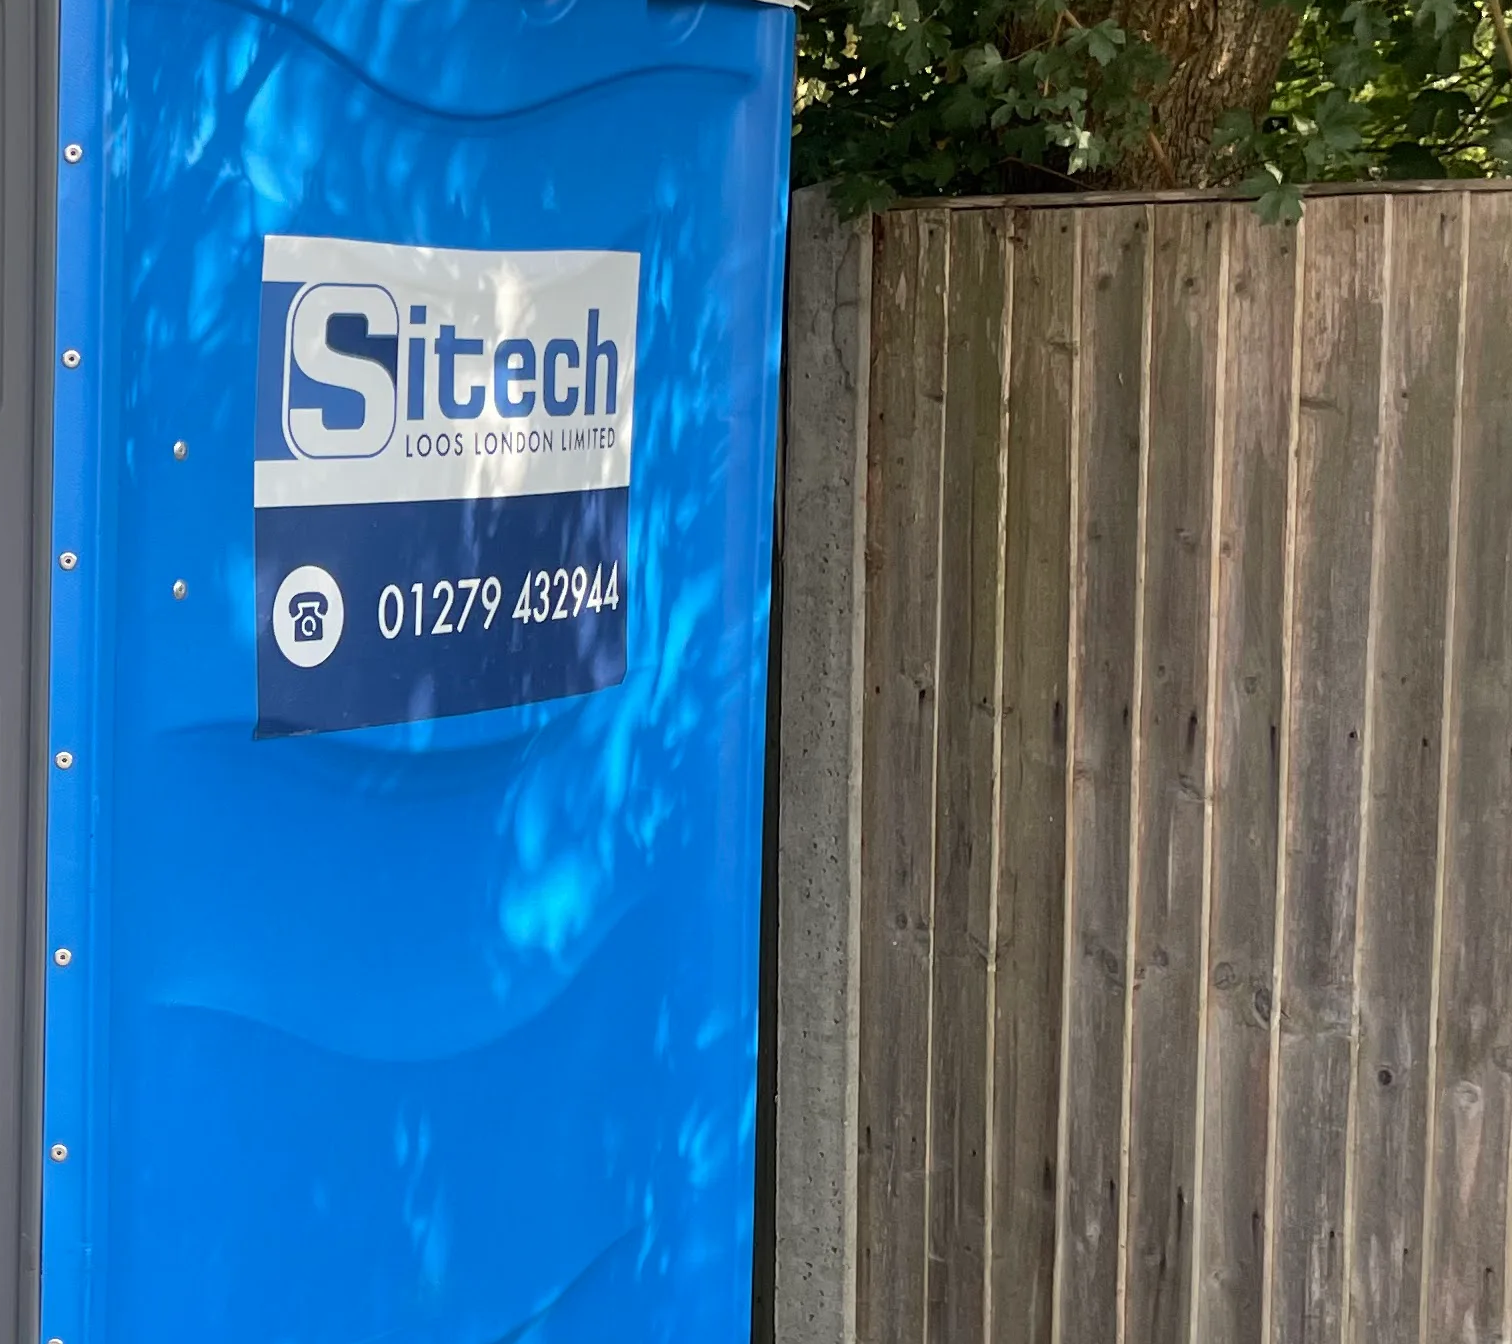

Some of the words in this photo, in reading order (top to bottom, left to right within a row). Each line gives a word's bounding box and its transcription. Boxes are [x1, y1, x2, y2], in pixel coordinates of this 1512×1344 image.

[288, 283, 618, 458] Sitech
[406, 433, 463, 457] LOOS
[475, 429, 553, 455] LONDON
[561, 427, 616, 451] LIMITED
[377, 576, 502, 639] 01279
[511, 560, 620, 624] 432944
